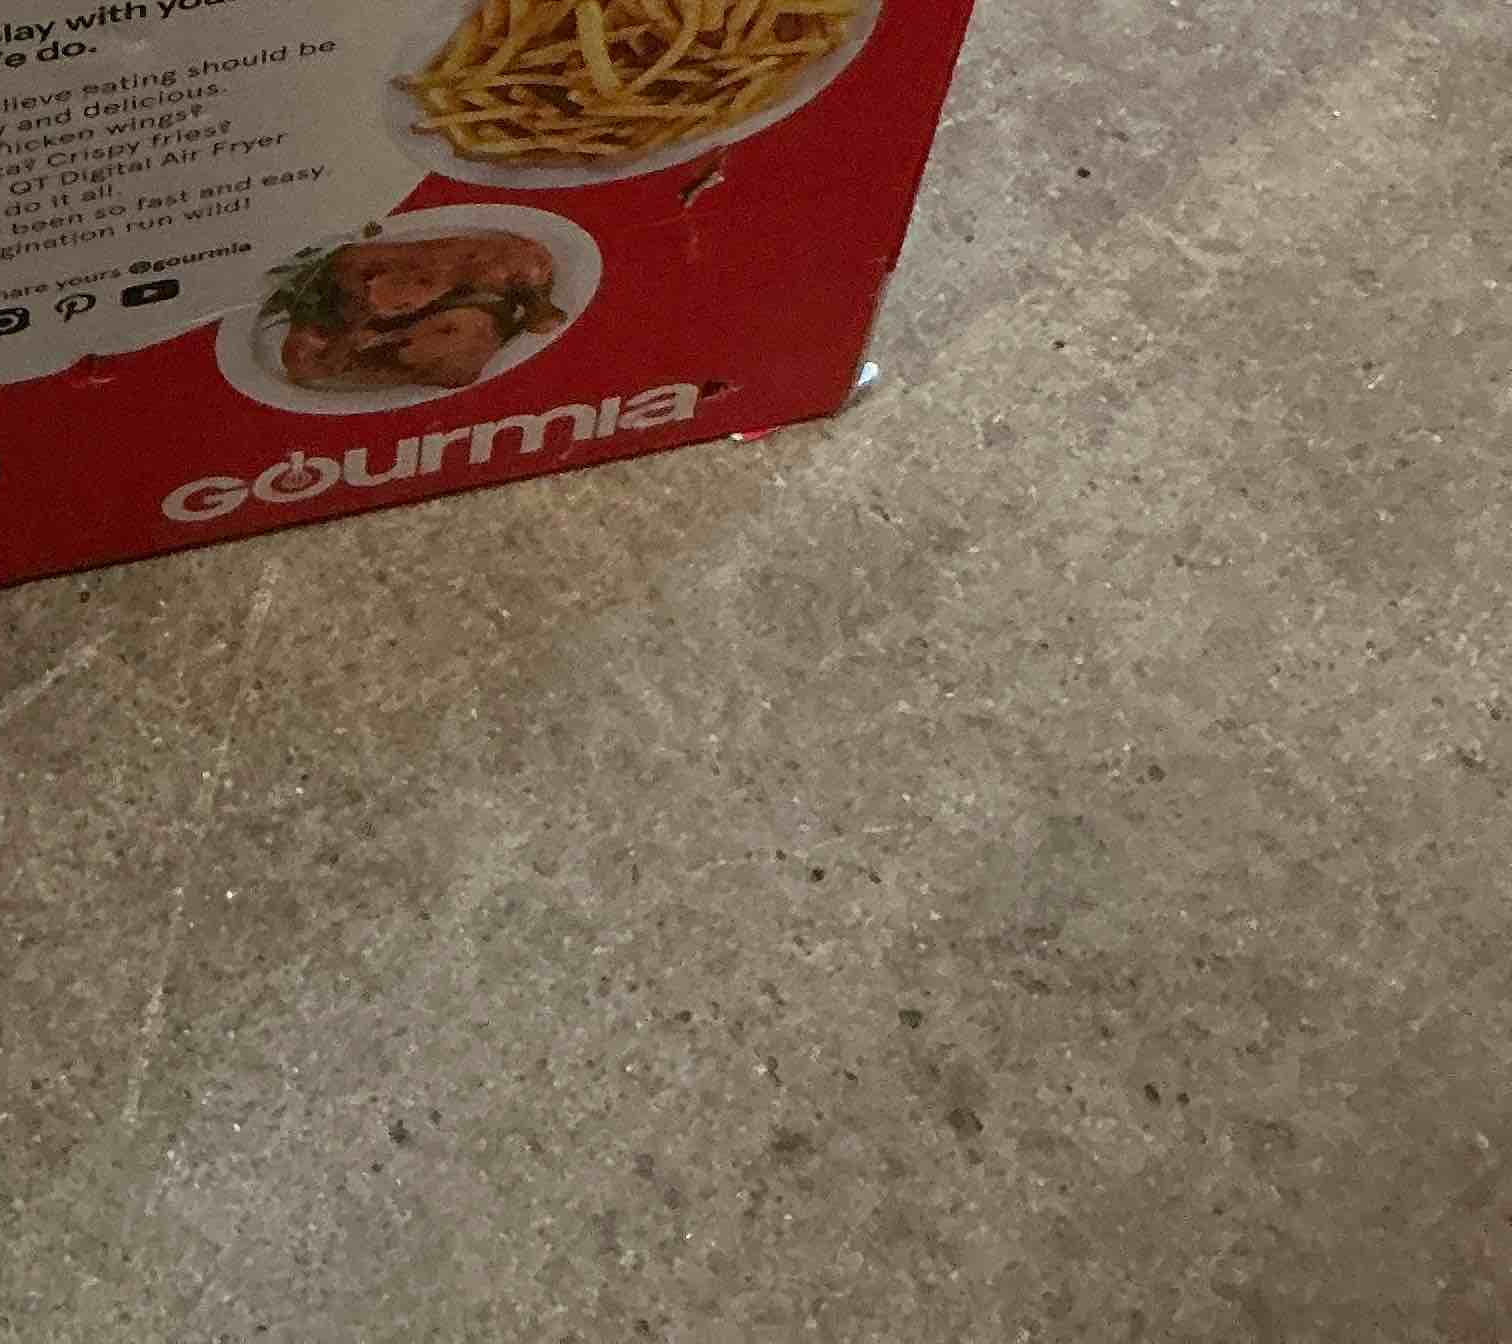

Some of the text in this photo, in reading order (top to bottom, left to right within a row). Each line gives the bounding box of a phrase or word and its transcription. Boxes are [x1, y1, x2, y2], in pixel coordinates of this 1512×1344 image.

[65, 1, 147, 31] with
[36, 40, 97, 62] do.
[82, 70, 177, 95] eating
[188, 46, 287, 78] should
[299, 40, 337, 57] be
[17, 107, 72, 132] and
[9, 175, 49, 196] QT
[60, 158, 151, 186] Digital
[160, 149, 197, 167] Air
[212, 134, 284, 156] Fryer
[47, 141, 140, 168] Crispy
[4, 201, 41, 217] do
[51, 194, 69, 209] it
[11, 213, 83, 235] been
[94, 205, 127, 220] so
[137, 190, 188, 211] fast
[199, 176, 251, 199] and
[126, 215, 173, 233] run
[128, 243, 252, 275] @gourmia
